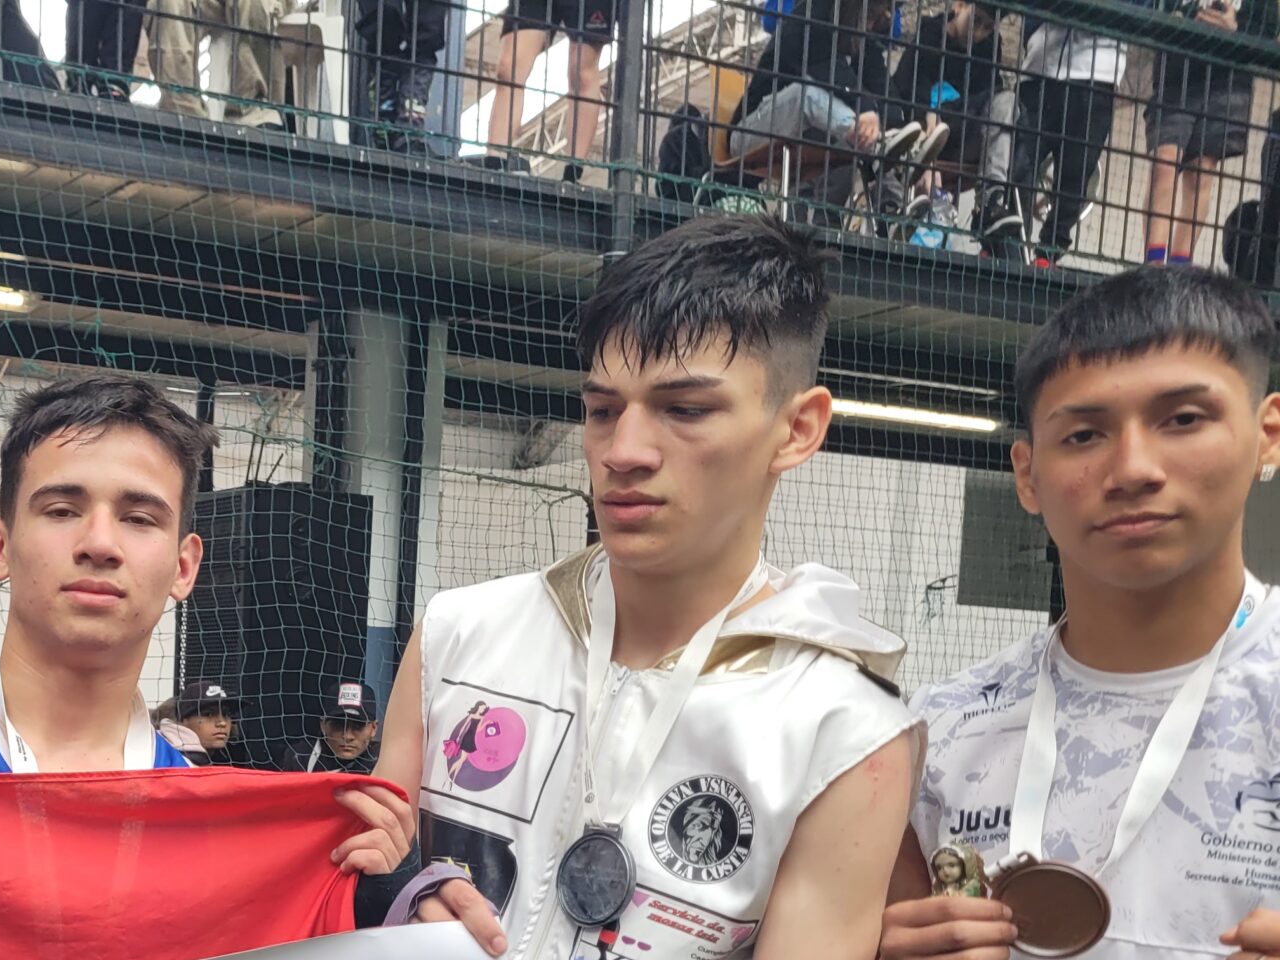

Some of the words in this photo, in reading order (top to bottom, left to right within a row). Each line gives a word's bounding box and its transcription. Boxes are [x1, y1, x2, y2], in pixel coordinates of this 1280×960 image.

[651, 781, 696, 836] NATIVO
[1200, 831, 1273, 853] Gobierno
[701, 845, 750, 881] COSTA
[1206, 849, 1261, 865] Ministerio
[671, 860, 694, 880] LA
